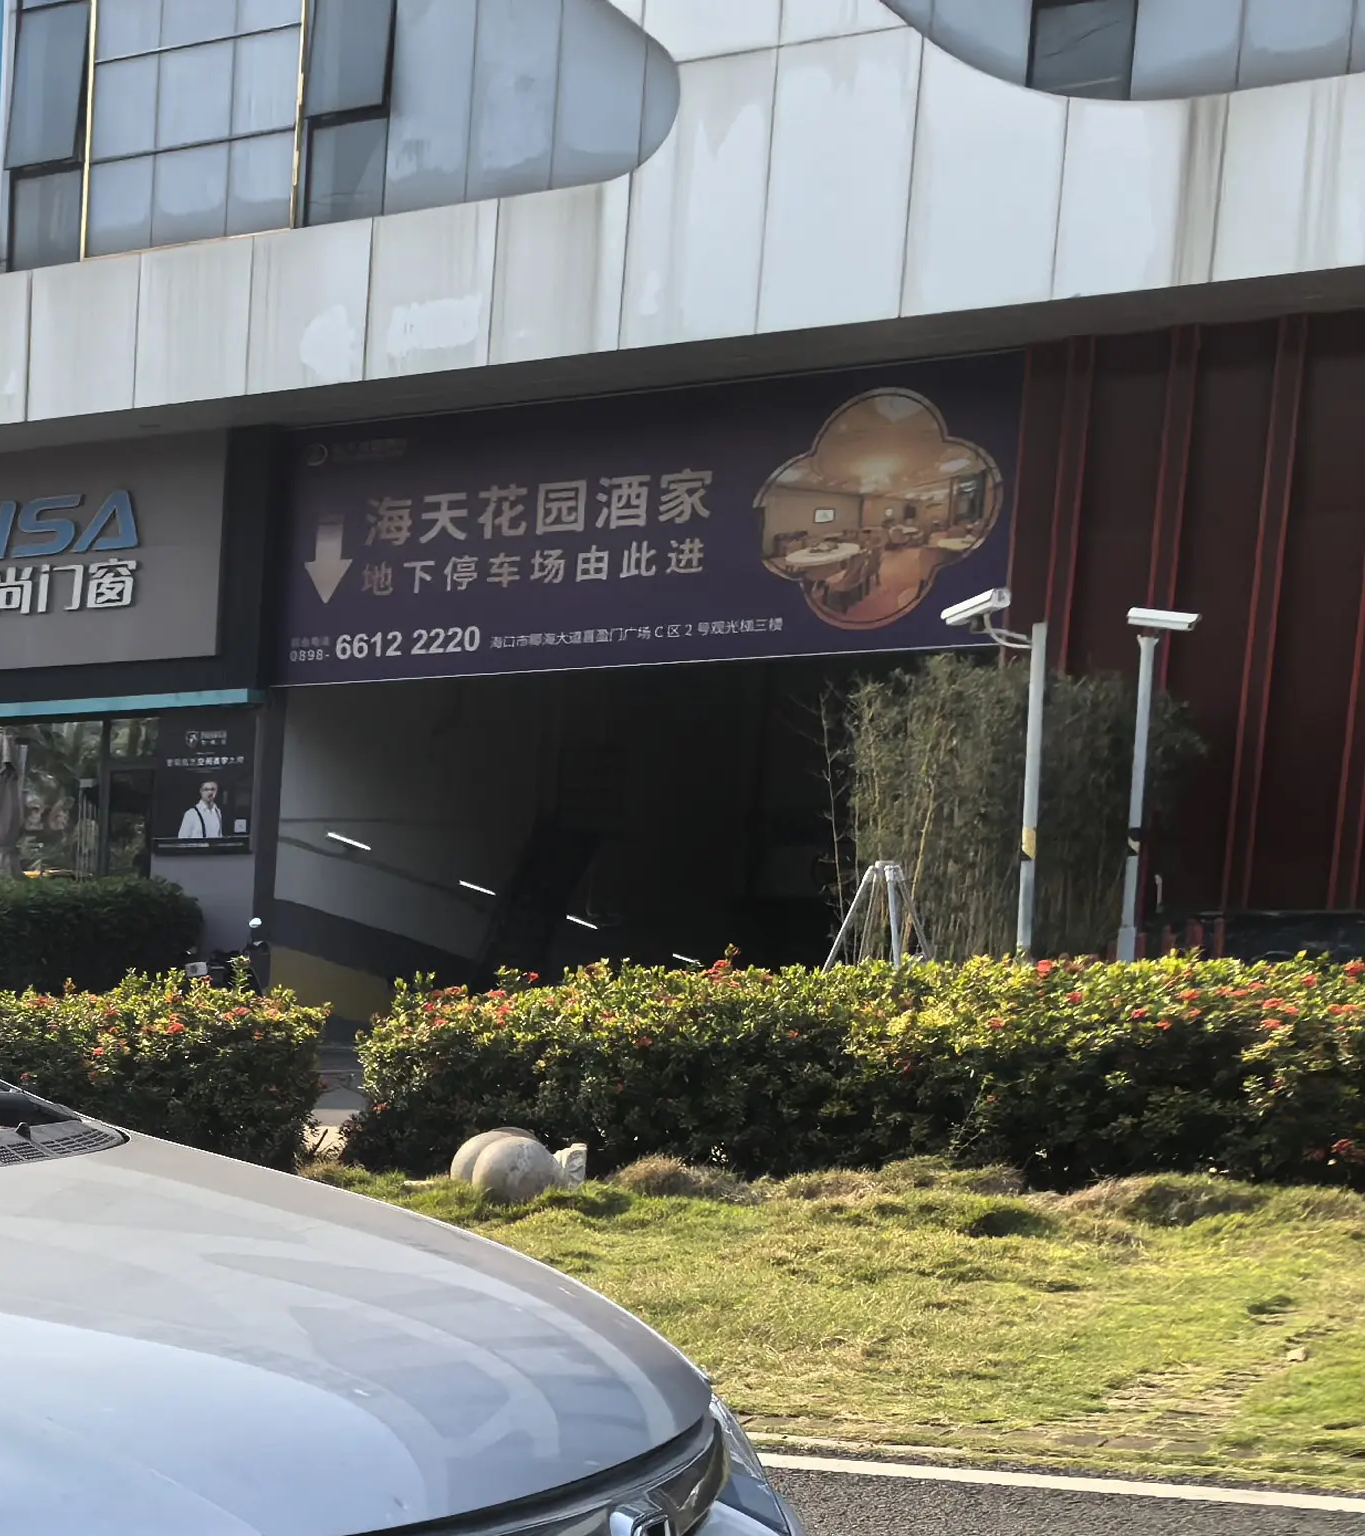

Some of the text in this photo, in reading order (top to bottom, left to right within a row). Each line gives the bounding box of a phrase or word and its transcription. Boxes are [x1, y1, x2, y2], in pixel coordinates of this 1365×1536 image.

[365, 469, 712, 547] 海天花园酒家
[361, 538, 704, 596] 地下停车场由此进
[335, 631, 402, 660] 6612
[410, 625, 481, 655] 2220
